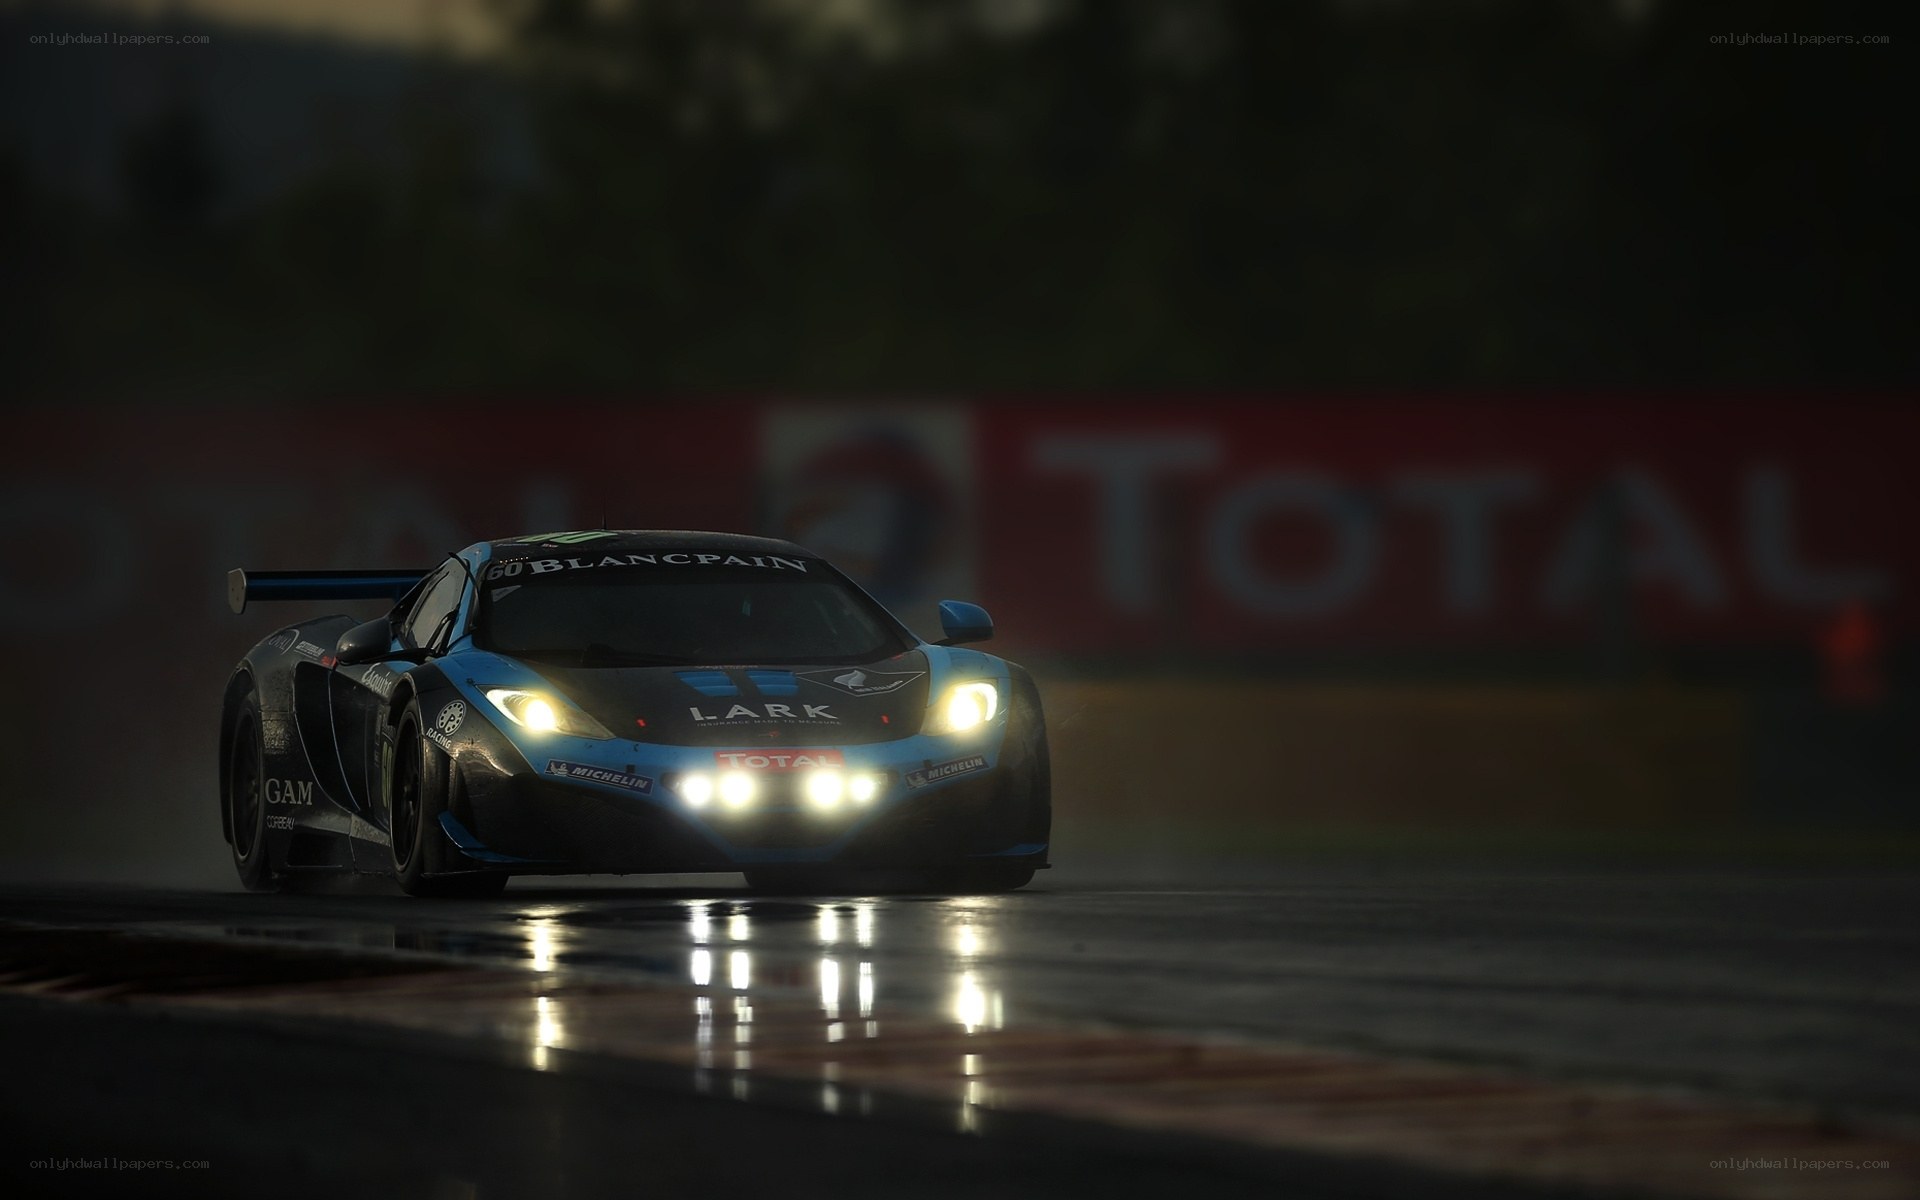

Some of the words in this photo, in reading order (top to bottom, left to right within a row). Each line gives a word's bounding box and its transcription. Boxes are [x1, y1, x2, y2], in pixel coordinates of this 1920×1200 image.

[1026, 427, 1895, 614] TOTAL
[486, 562, 523, 580] 60
[526, 553, 808, 575] BLANCPAIN
[689, 704, 840, 721] LARK
[426, 727, 452, 749] RACING
[719, 753, 841, 769] TOTAL
[928, 758, 983, 779] MICHELIN
[572, 766, 648, 789] MICHELIN
[264, 777, 313, 806] GAM
